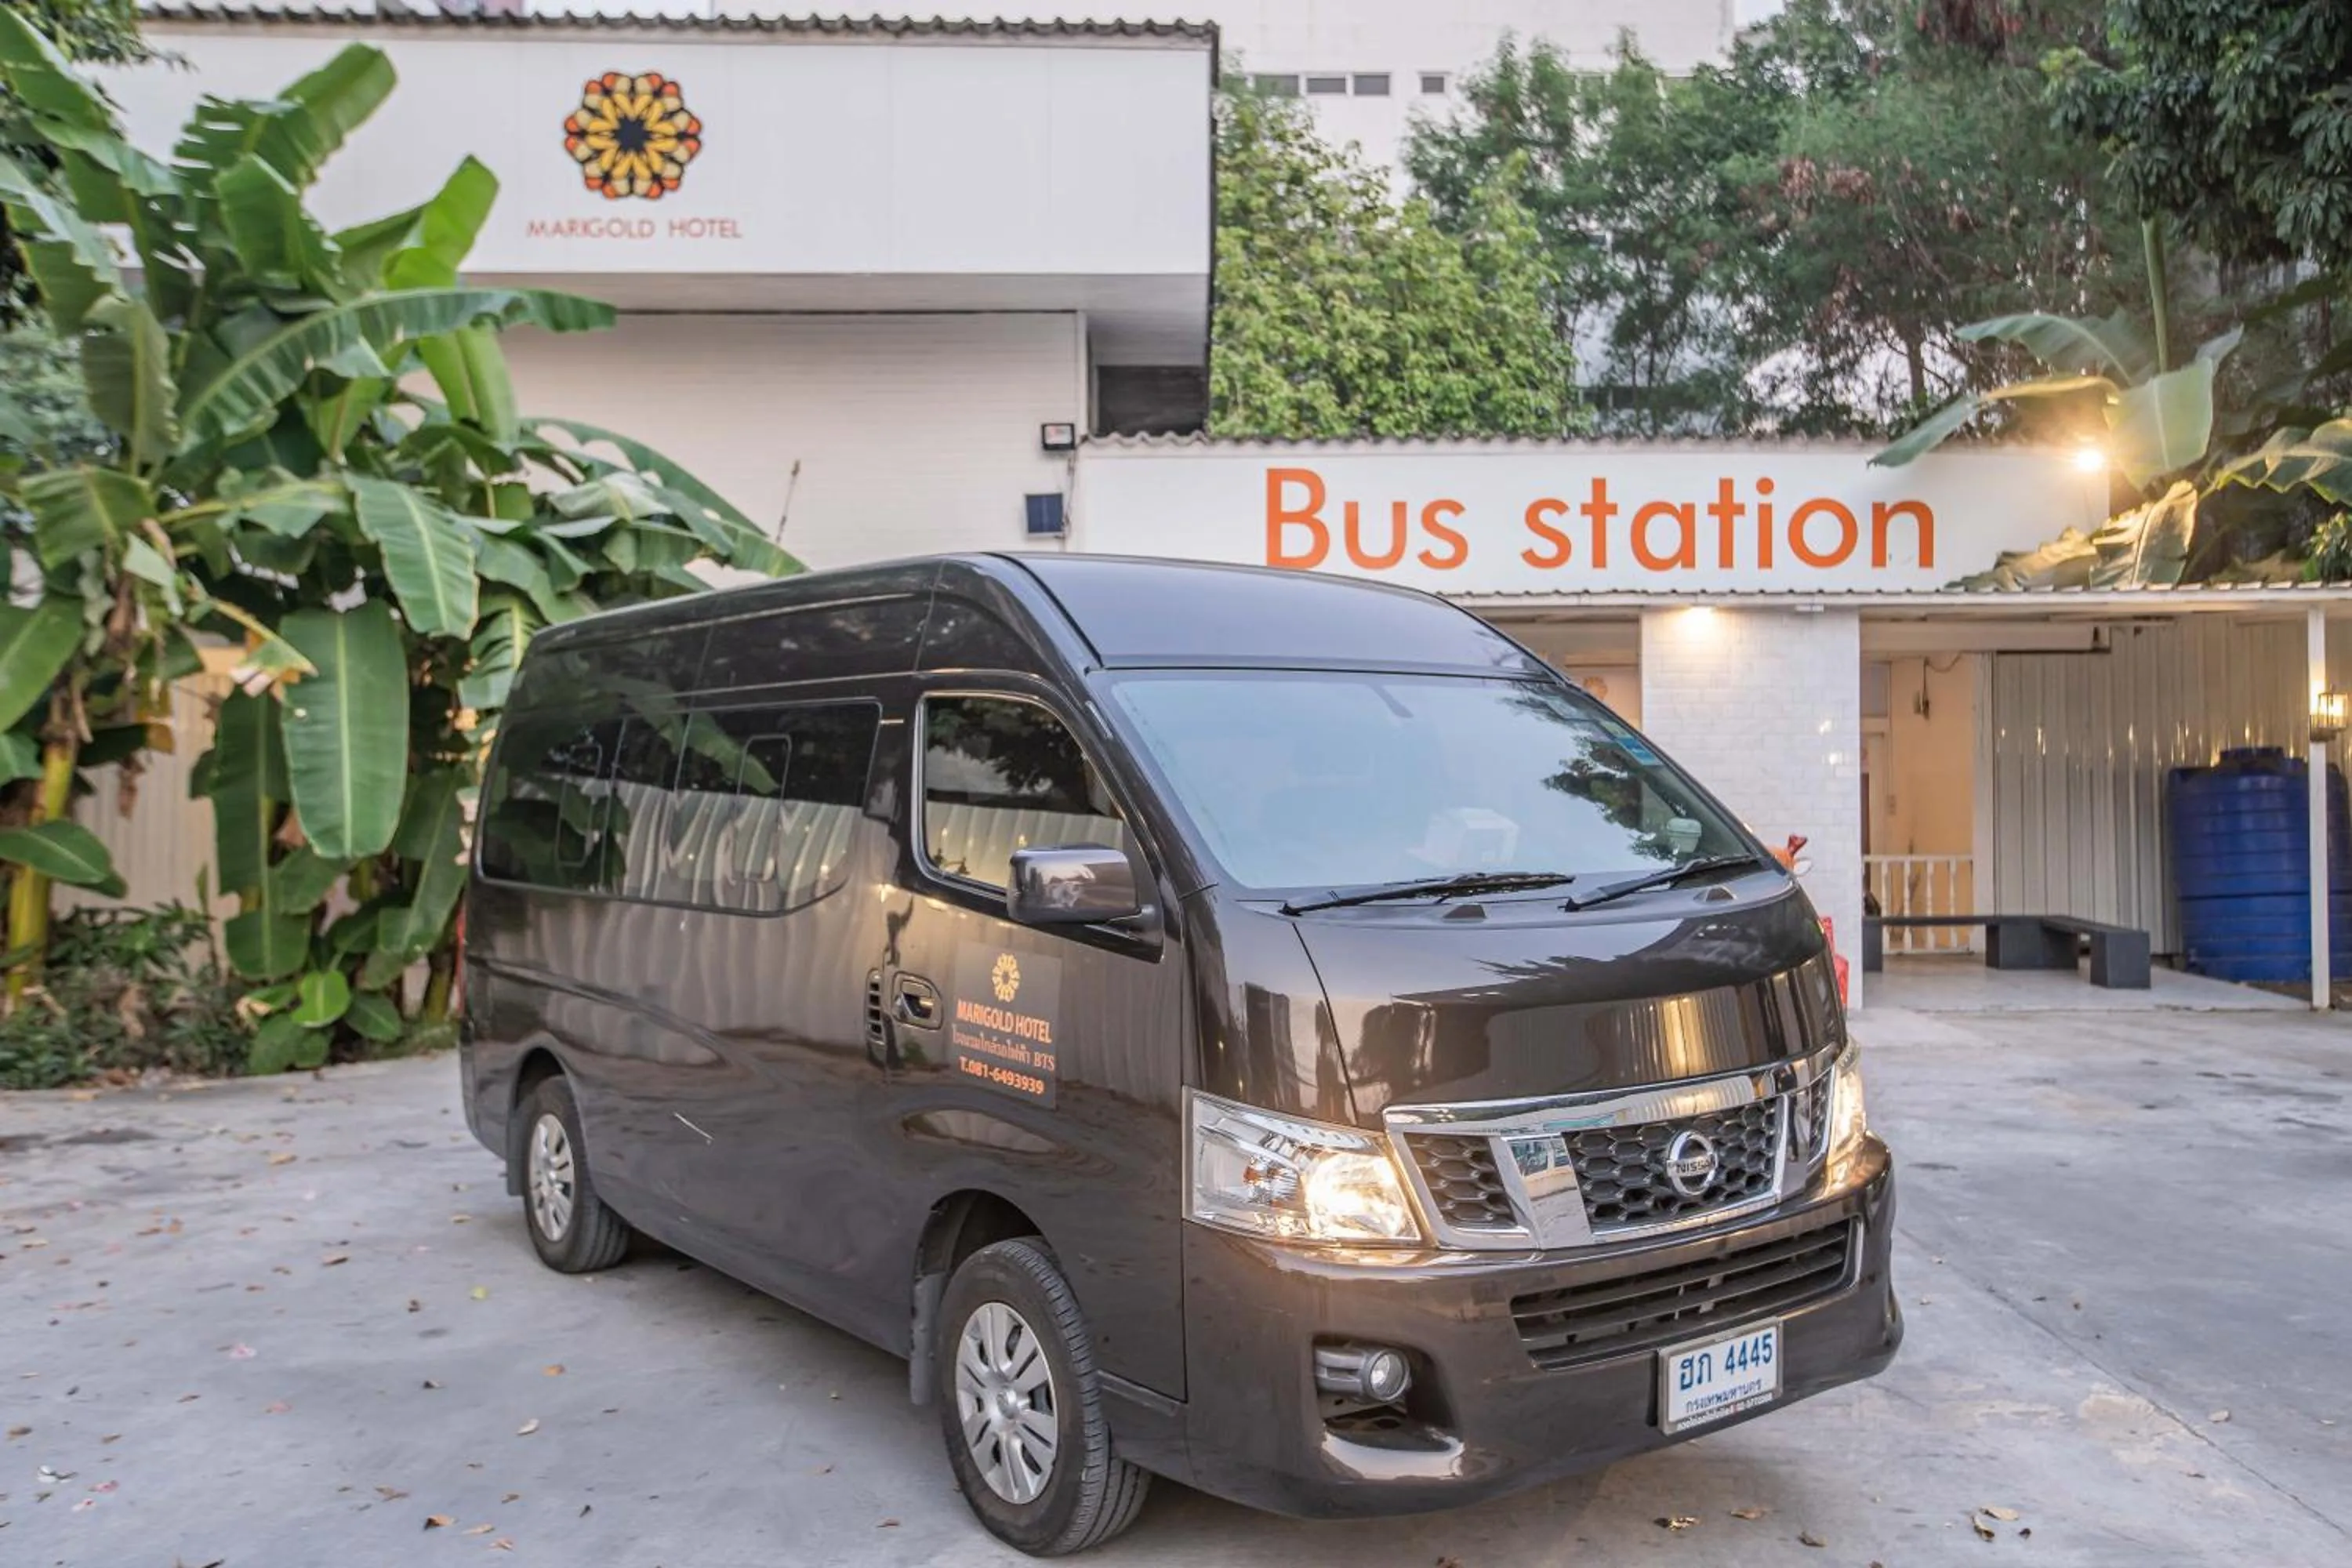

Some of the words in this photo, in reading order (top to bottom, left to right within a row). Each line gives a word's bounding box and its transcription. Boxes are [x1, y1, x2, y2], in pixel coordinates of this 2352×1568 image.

[527, 217, 655, 238] MARIGOLD
[668, 217, 742, 238] HOTEL
[1265, 467, 1468, 571] Bus
[1520, 477, 1934, 572] station
[956, 999, 1014, 1033] MARIGOLD
[1015, 1014, 1052, 1044] HOTEL
[1034, 1051, 1054, 1071] BTS
[1726, 1333, 1773, 1374] 4445
